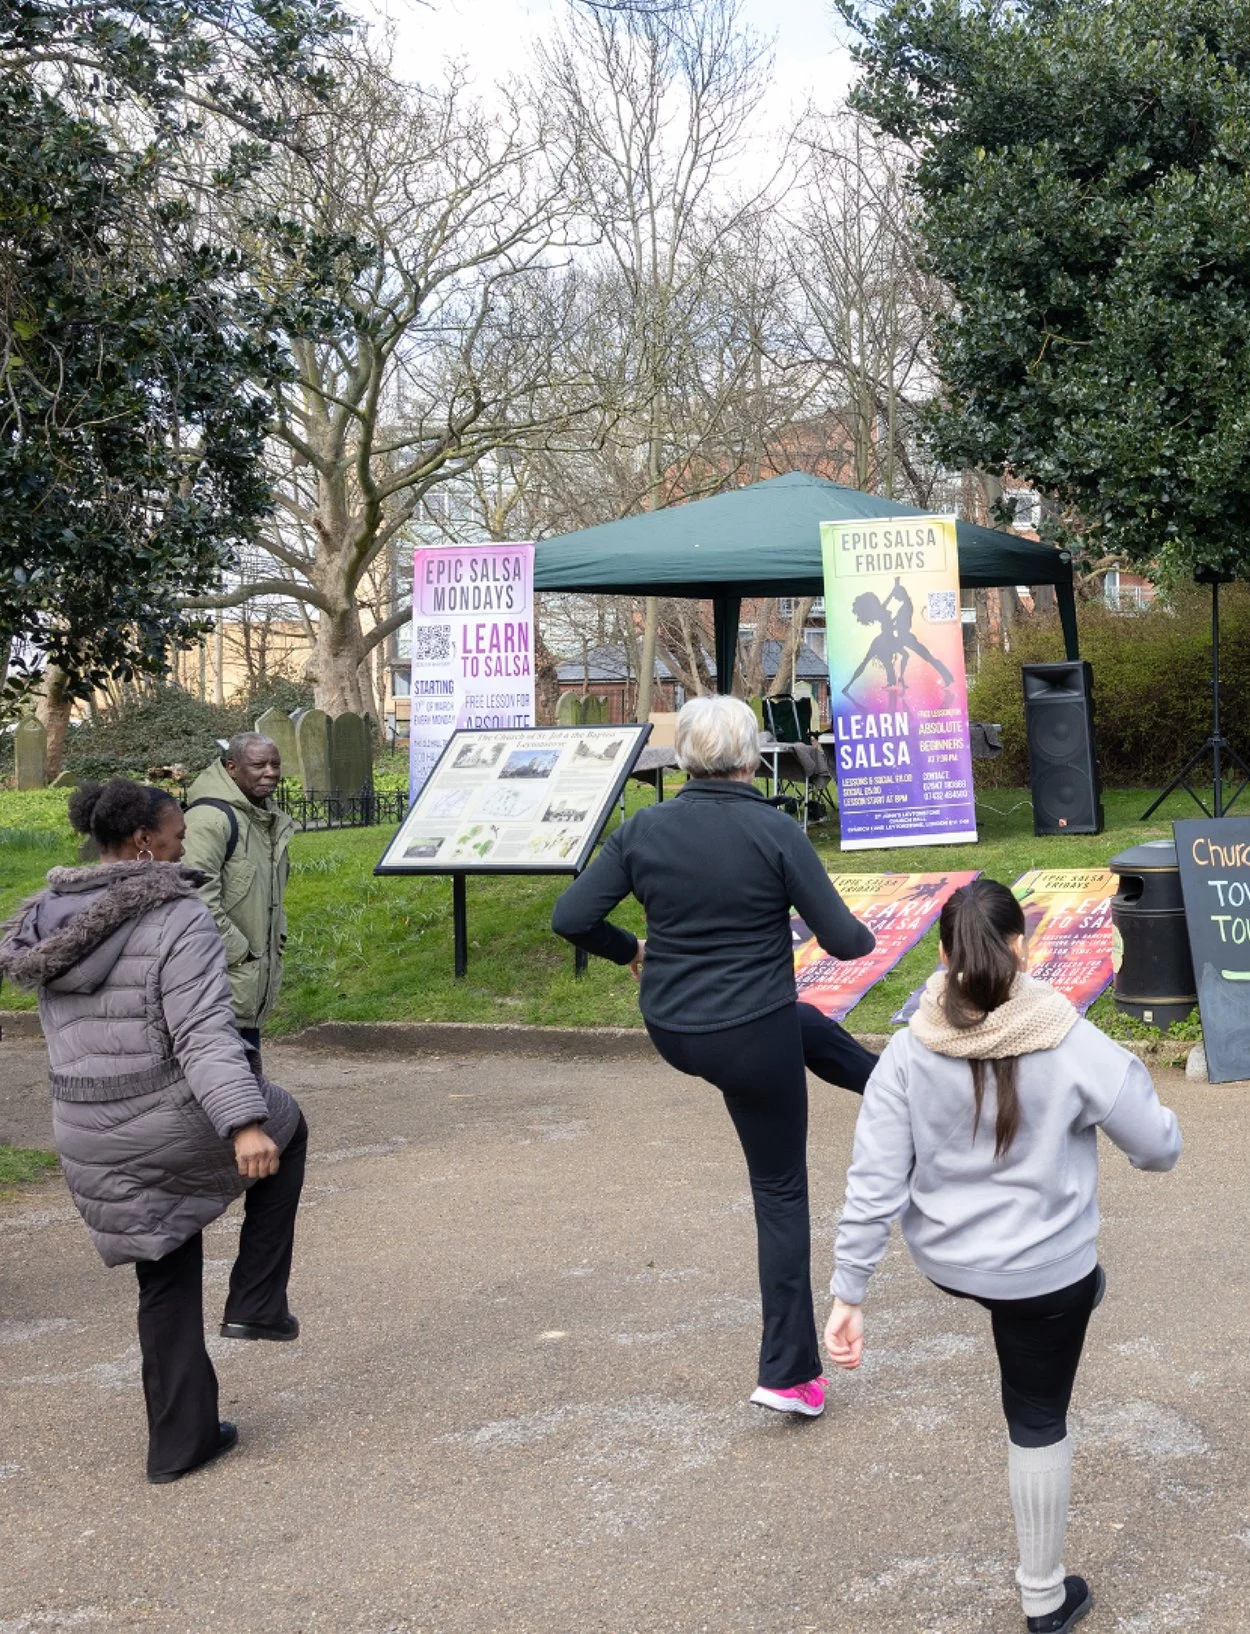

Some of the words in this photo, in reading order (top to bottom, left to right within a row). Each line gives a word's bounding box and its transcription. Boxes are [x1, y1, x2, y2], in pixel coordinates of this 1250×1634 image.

[842, 532, 878, 551] EPIC
[884, 528, 936, 548] SALSA
[856, 551, 925, 572] FRIDAYS
[426, 559, 463, 584] EPIC
[470, 557, 521, 583] SALSA
[433, 585, 514, 611] MONDAYS
[462, 622, 530, 654] LEARN
[461, 656, 479, 678] TO
[484, 655, 530, 677] SALSA
[414, 679, 454, 695] STARTING
[465, 695, 484, 708] FREE
[486, 694, 515, 708] LESSON
[516, 694, 530, 707] FOR
[466, 715, 530, 728] ABSOLUTE
[837, 711, 909, 740] LEARN
[918, 721, 963, 735] ABSOLUTE
[493, 733, 524, 741] Church
[527, 732, 537, 740] of
[920, 738, 964, 752] BEGINNERS
[840, 741, 911, 770] SALSA
[865, 879, 899, 887] SALSA
[1057, 898, 1111, 915] LEA
[867, 917, 922, 931] SALSA
[1048, 916, 1072, 929] TO
[1079, 916, 1113, 929] SAL
[798, 966, 872, 977] ABSOLUTE
